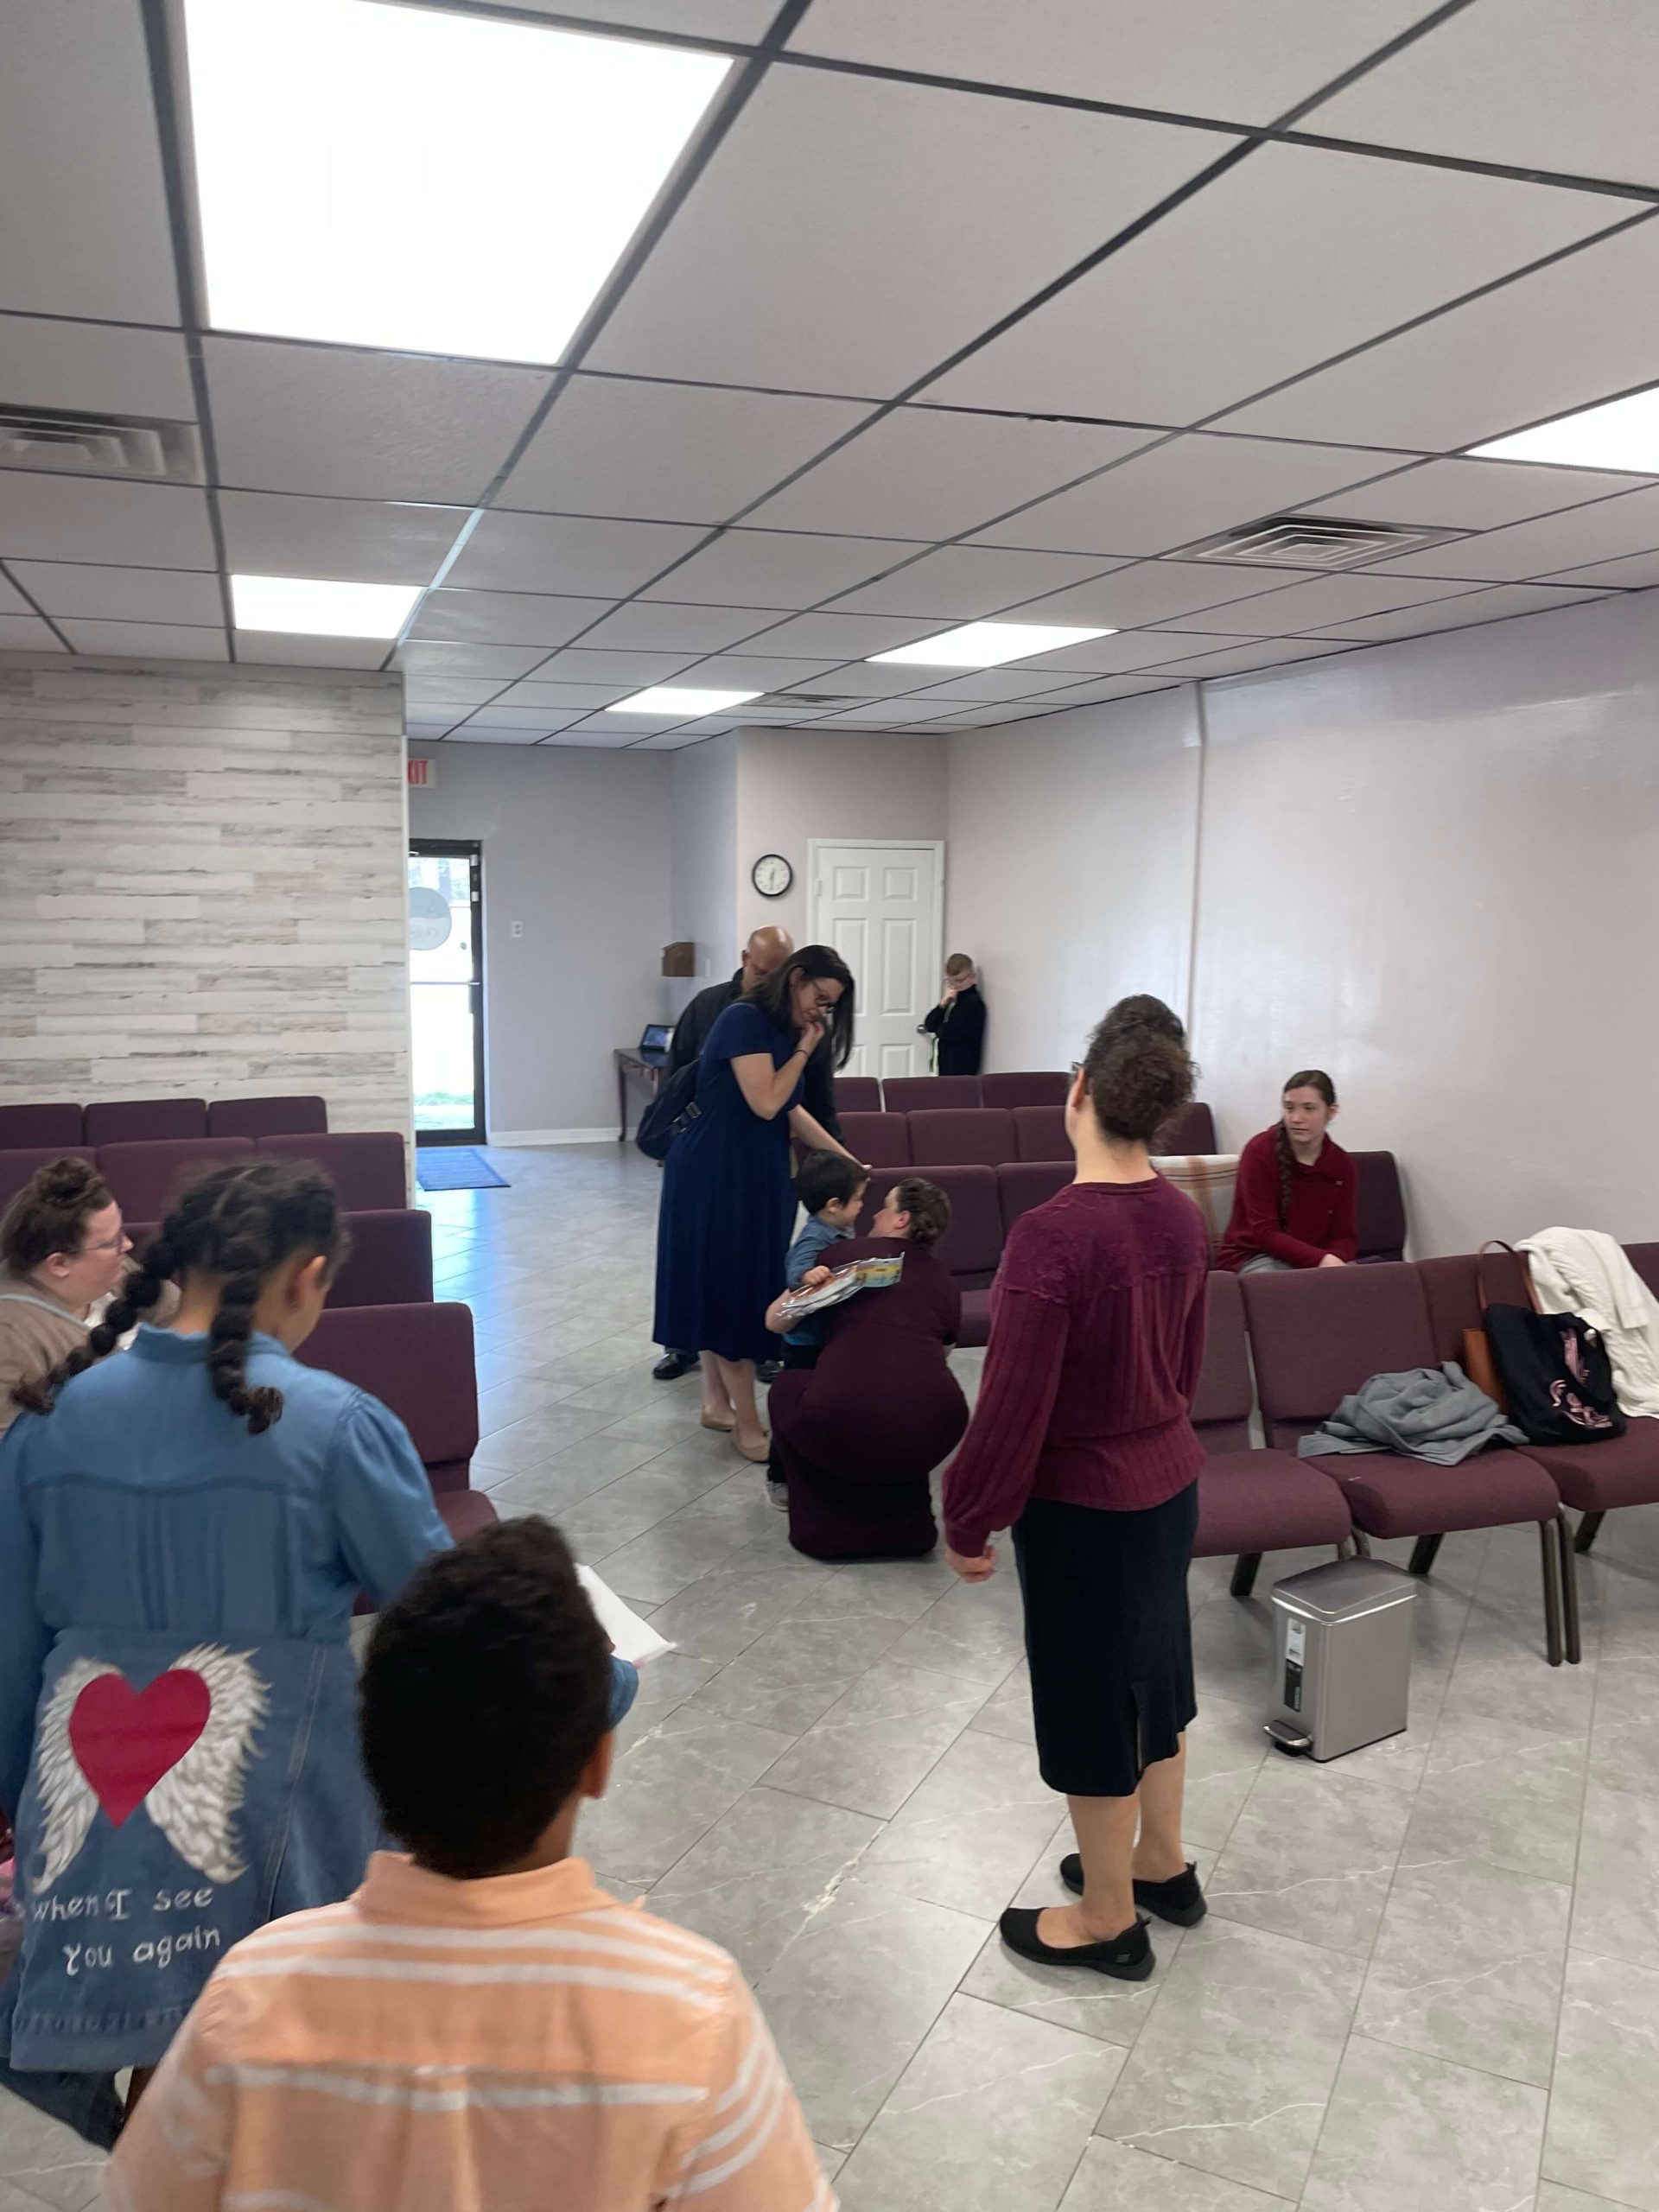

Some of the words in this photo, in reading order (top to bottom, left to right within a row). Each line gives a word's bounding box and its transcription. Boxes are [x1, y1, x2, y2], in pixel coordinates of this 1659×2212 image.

[105, 1888, 131, 1922] I
[152, 1887, 213, 1911] see
[132, 1925, 220, 1969] again
